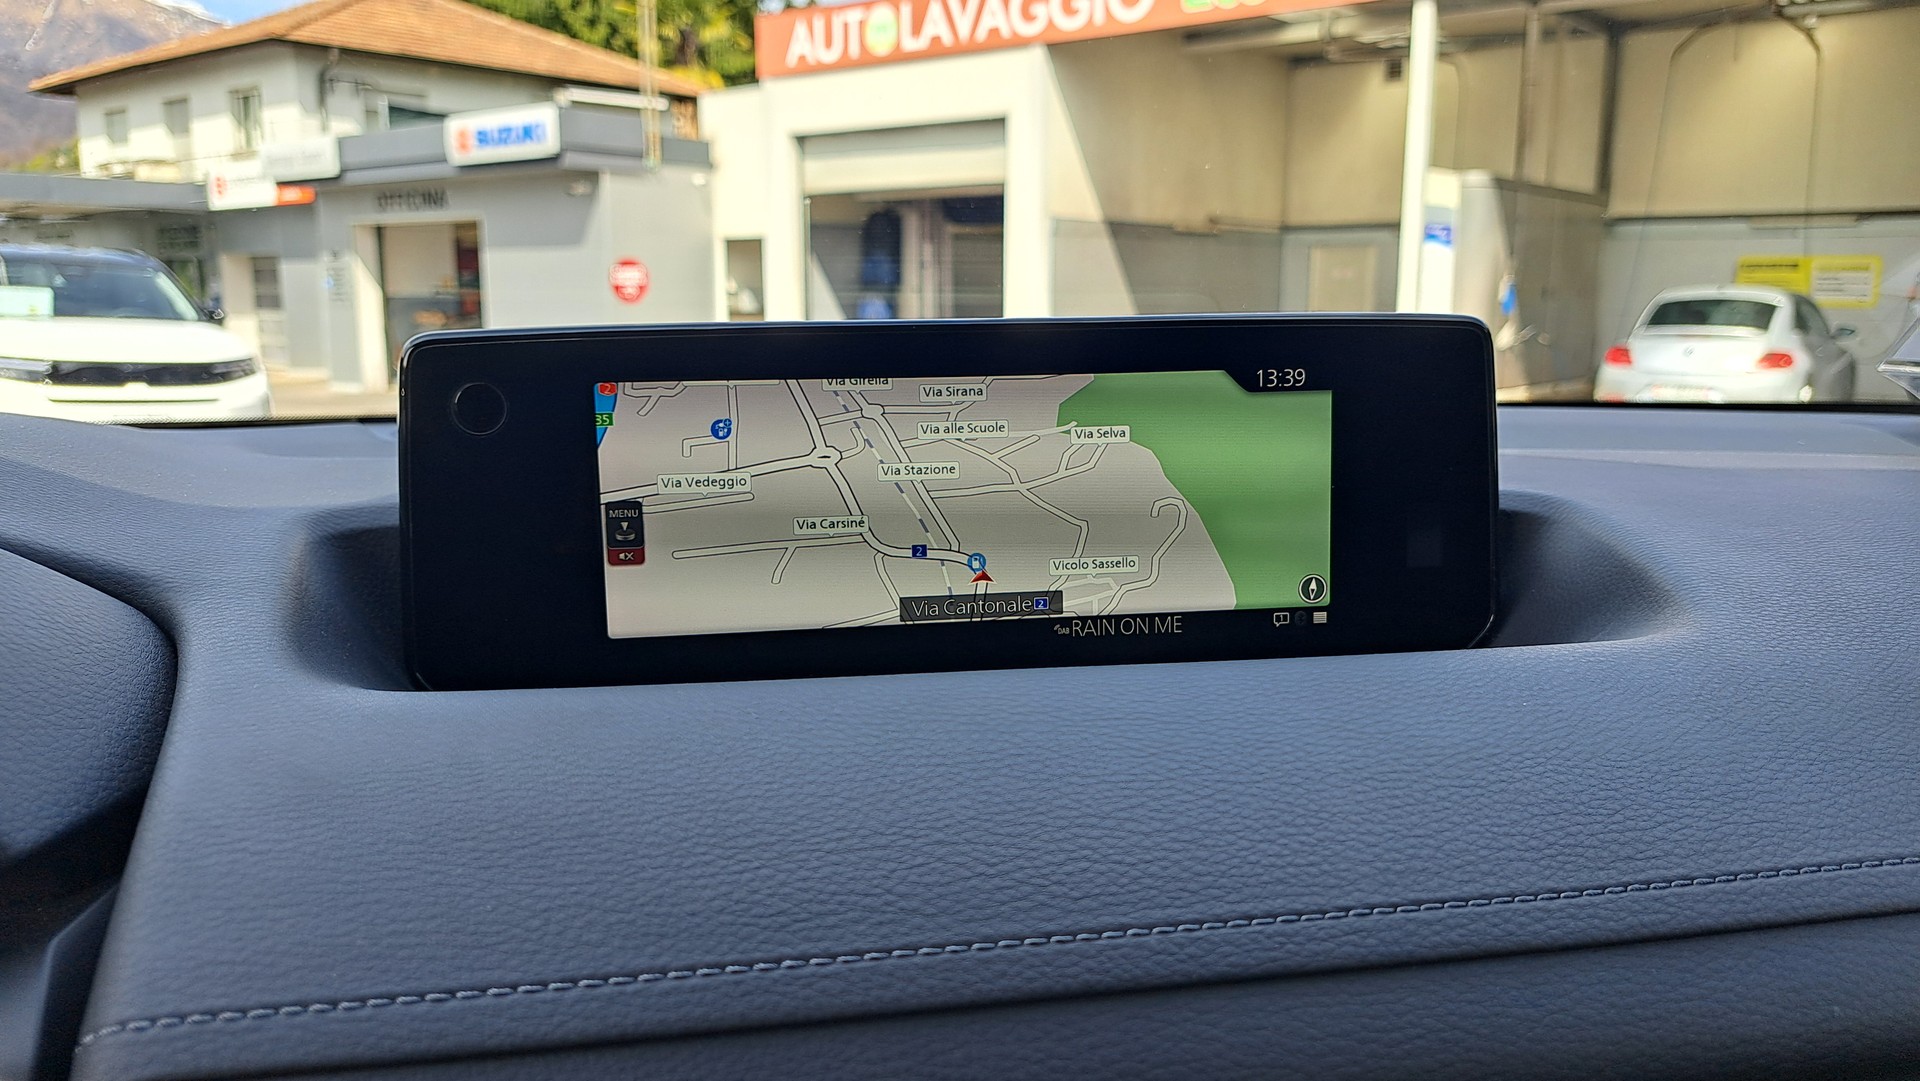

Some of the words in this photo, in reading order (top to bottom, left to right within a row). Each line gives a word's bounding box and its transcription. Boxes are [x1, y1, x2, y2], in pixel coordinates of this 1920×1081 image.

[476, 120, 547, 147] SUZUKI
[1256, 368, 1306, 388] 13:39
[604, 384, 611, 394] 2
[922, 387, 943, 398] Via
[946, 386, 983, 397] Sirana
[920, 424, 940, 435] Via
[943, 423, 964, 433] alle
[967, 421, 1006, 434] Scuole
[1074, 428, 1094, 440] Via
[1097, 427, 1126, 439] Selva
[881, 465, 901, 477] Via
[904, 464, 956, 476] Stazione
[661, 476, 682, 488] Via
[685, 475, 747, 491] Vedeggio
[609, 508, 639, 519] MENU
[797, 519, 816, 530] Via
[819, 517, 865, 530] Carsiné
[916, 547, 923, 557] 2
[1053, 560, 1089, 571] Vicolo
[1092, 558, 1136, 569] Sassello
[912, 600, 939, 616] Via
[943, 595, 1032, 615] Cantonale
[1038, 599, 1045, 609] 2
[1072, 619, 1116, 637] RAIN
[1120, 617, 1149, 635] ON
[1155, 616, 1182, 633] ME
